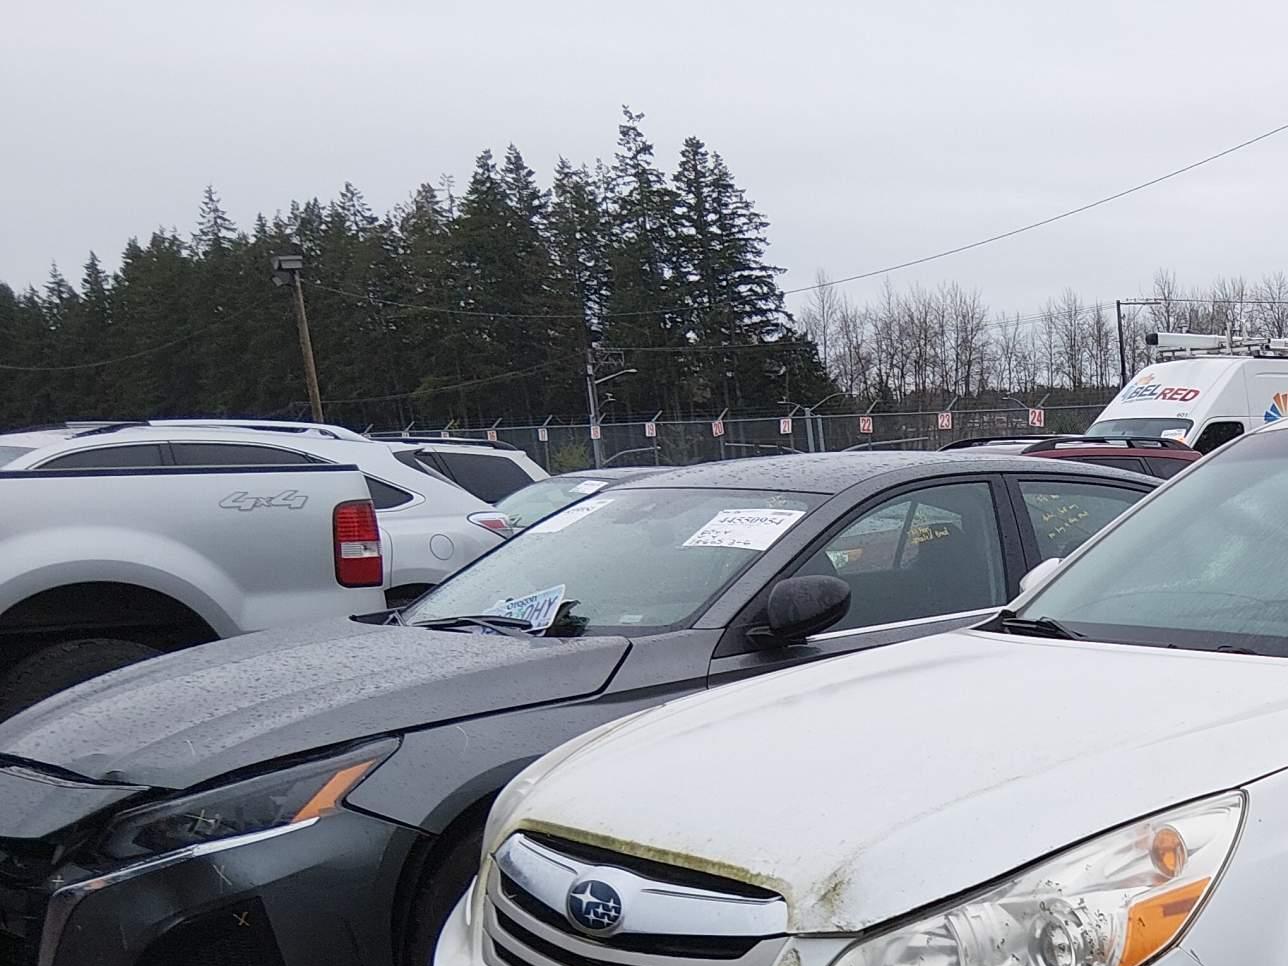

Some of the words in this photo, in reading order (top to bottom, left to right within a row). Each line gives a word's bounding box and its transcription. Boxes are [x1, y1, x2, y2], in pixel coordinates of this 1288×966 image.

[939, 413, 950, 428] 23
[1030, 410, 1043, 425] 24
[647, 422, 655, 436] 19
[713, 421, 723, 435] 20
[782, 419, 791, 433] 21
[861, 418, 872, 432] 22
[219, 490, 309, 512] 4x4
